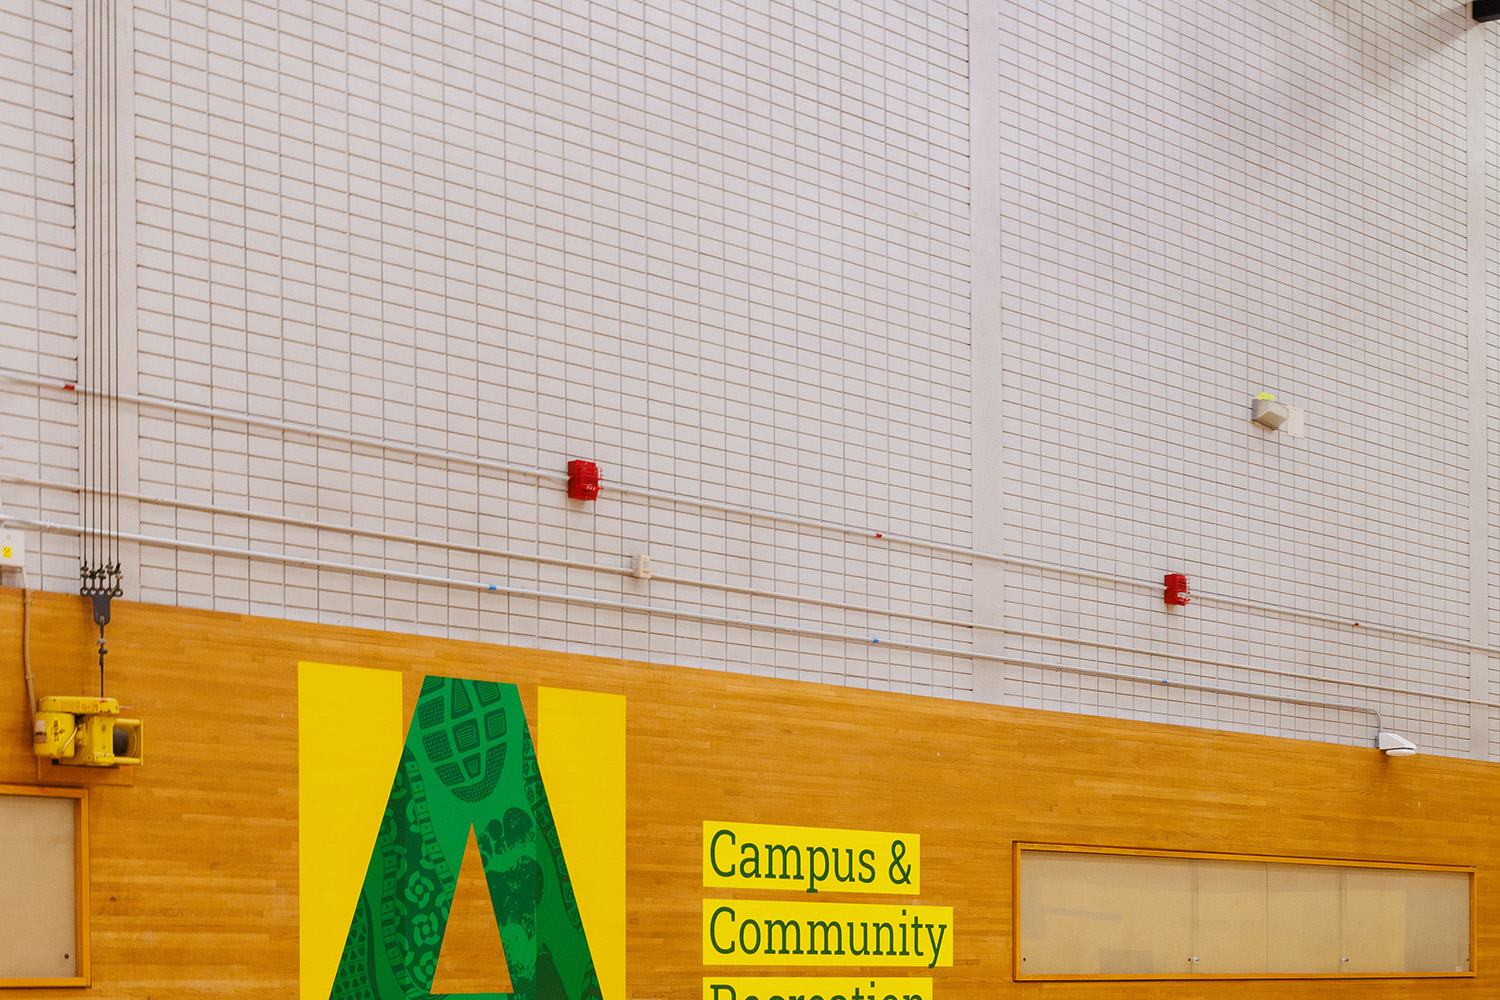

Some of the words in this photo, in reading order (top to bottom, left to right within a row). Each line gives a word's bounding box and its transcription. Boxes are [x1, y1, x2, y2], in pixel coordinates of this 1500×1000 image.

[709, 829, 876, 893] Campus
[888, 839, 912, 885] &
[709, 906, 947, 968] Community
